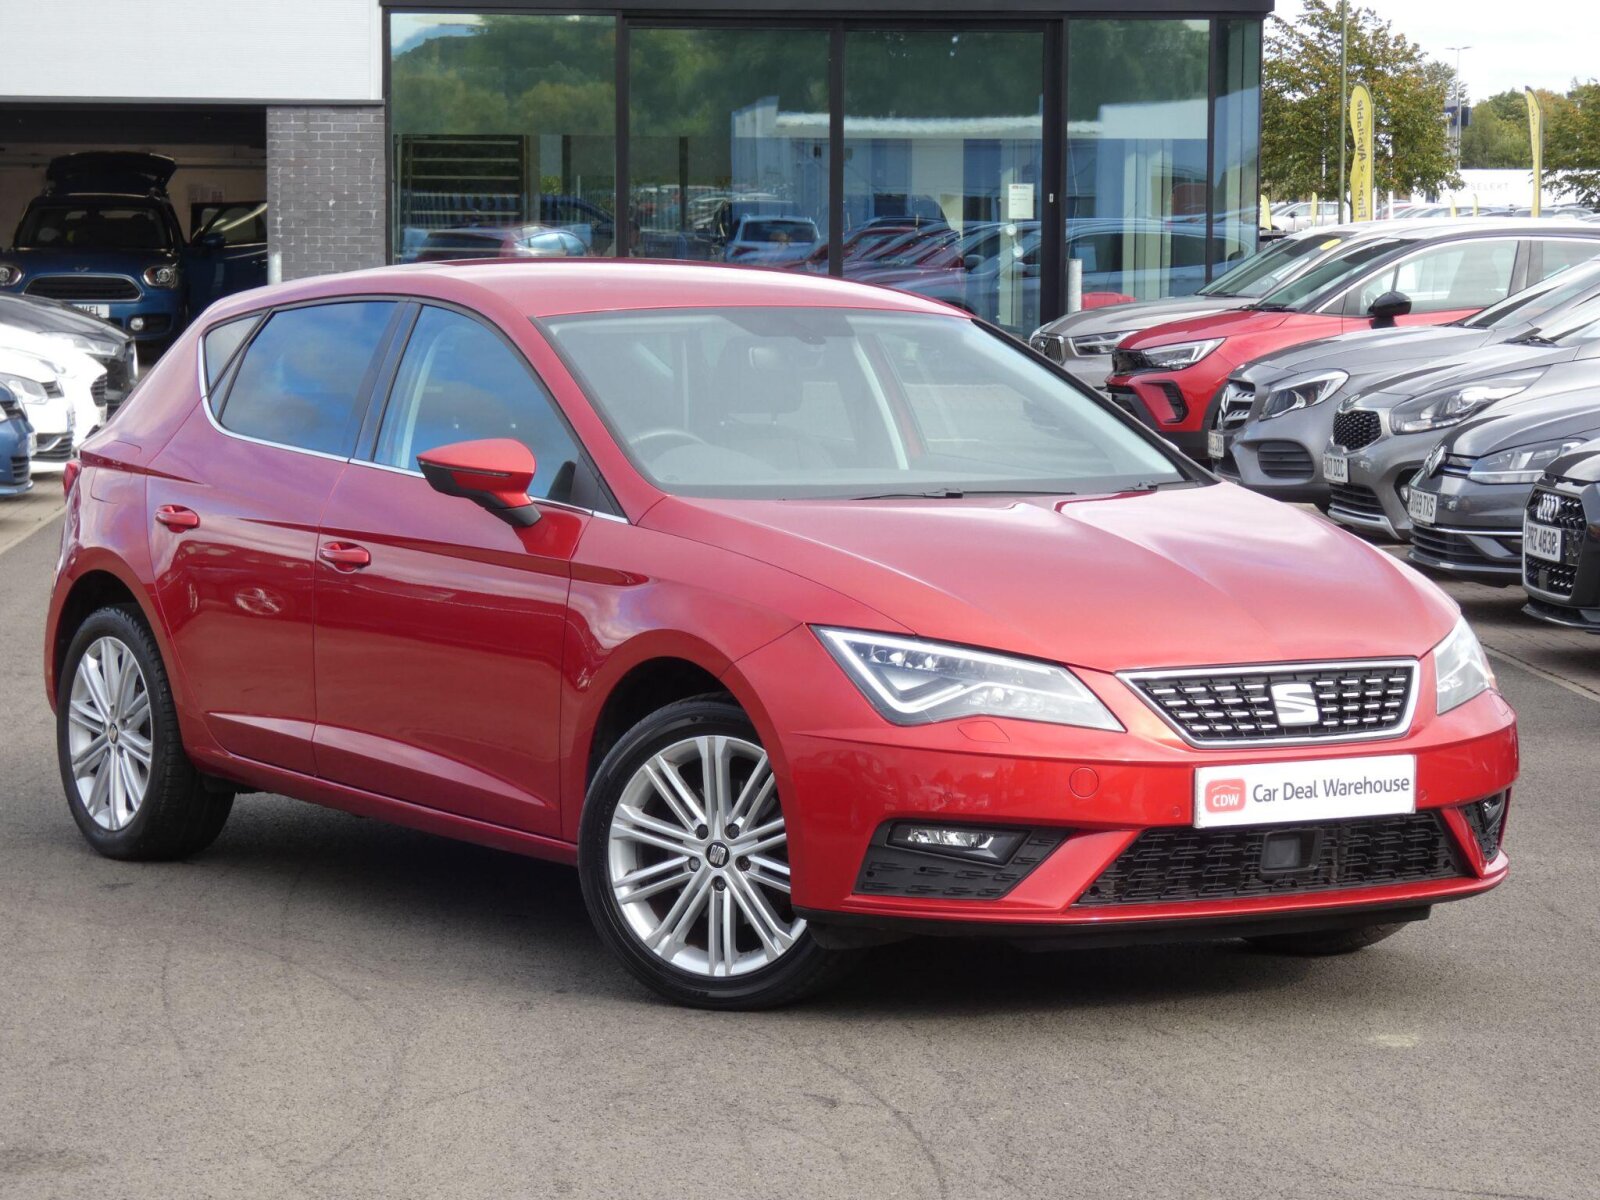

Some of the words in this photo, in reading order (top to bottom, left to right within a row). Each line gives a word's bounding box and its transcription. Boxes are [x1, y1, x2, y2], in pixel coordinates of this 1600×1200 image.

[1527, 525, 1538, 551] PRZ
[1212, 793, 1240, 808] CDW
[1252, 784, 1279, 803] Car
[1283, 780, 1319, 801] Deal
[1323, 776, 1410, 797] Warehouse
